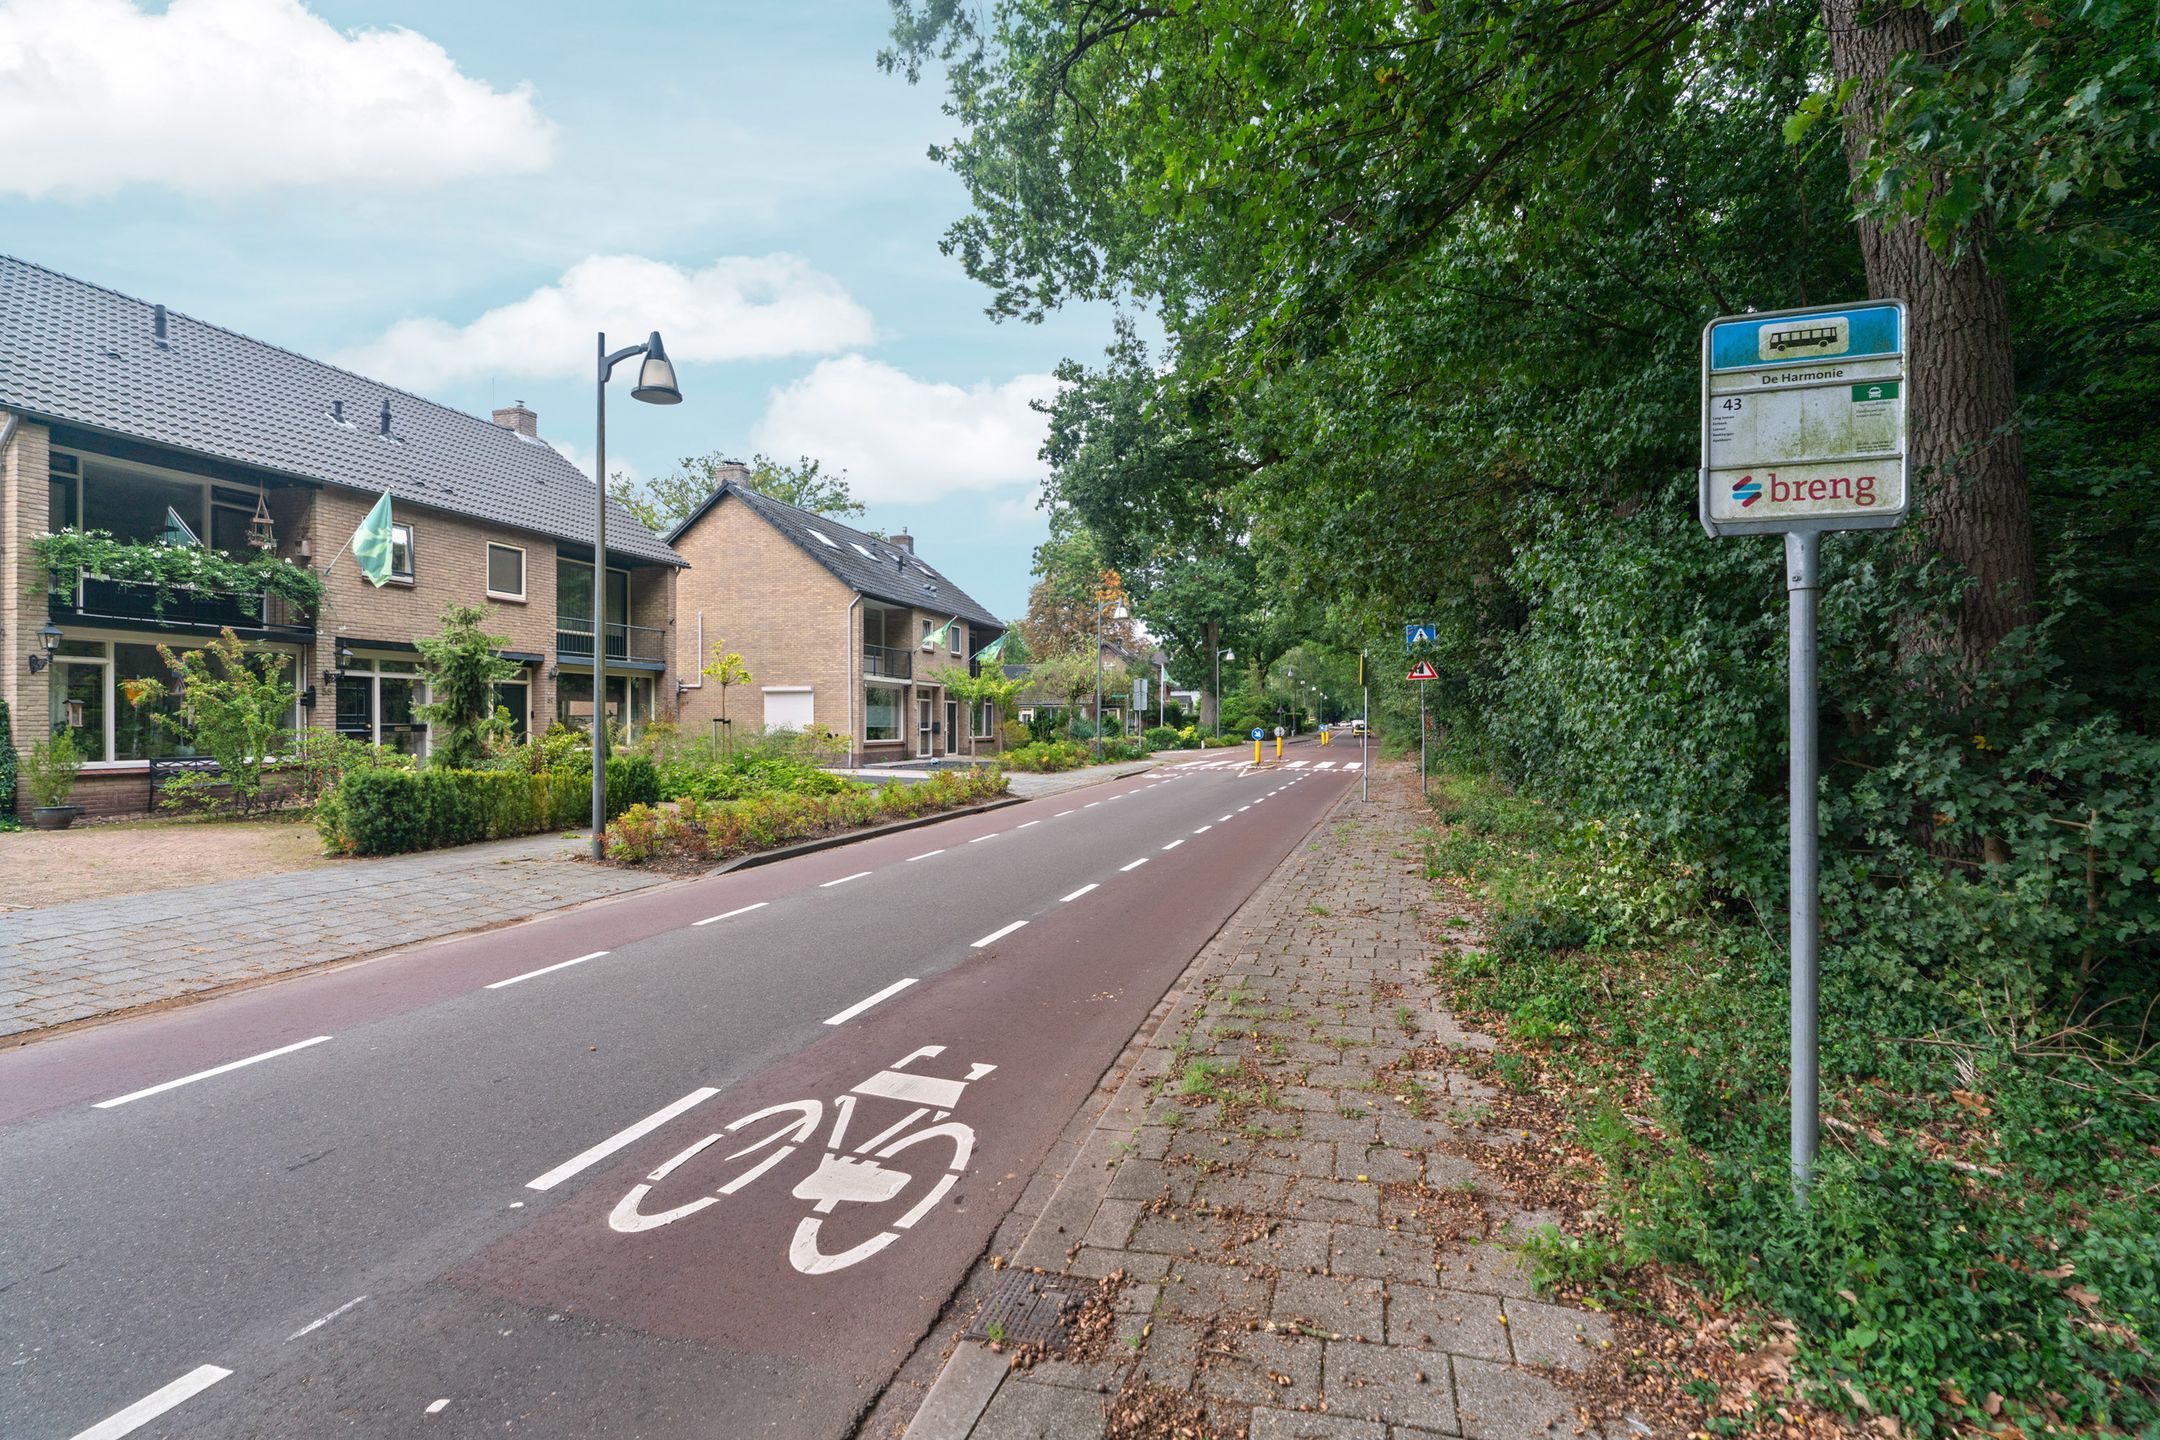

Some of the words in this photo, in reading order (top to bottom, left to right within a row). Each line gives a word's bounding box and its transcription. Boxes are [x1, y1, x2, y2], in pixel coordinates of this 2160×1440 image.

[1762, 375, 1778, 385] De
[1781, 368, 1844, 383] Harmonie
[1722, 398, 1742, 411] 43
[1767, 472, 1877, 507] breng
